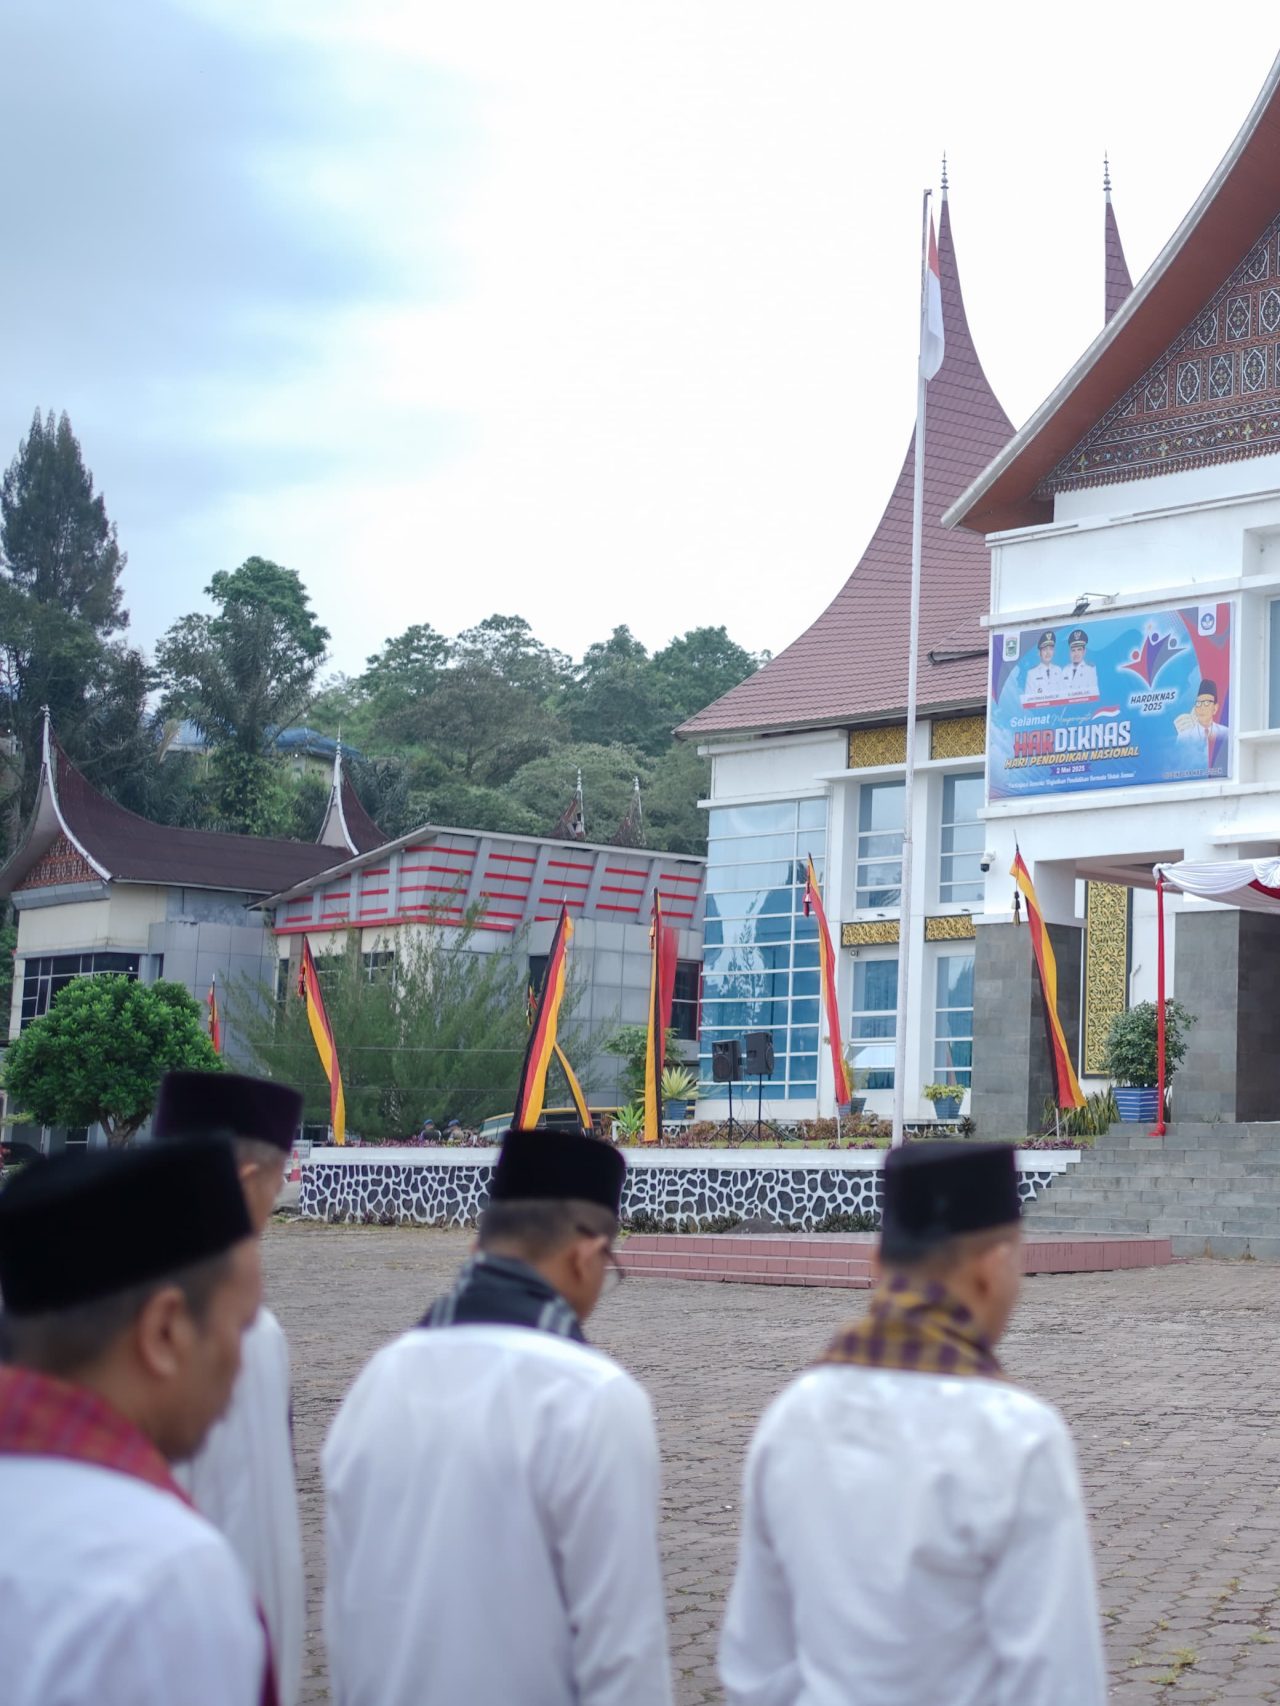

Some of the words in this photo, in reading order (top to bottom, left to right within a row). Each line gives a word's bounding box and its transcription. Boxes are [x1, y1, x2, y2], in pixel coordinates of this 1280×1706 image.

[1131, 691, 1176, 704] HARDIKNAS
[1143, 701, 1163, 712] 2025
[1010, 714, 1051, 728] Selamat
[1013, 720, 1132, 758] HARDIKNAS
[1004, 756, 1029, 769] HARI
[1030, 751, 1089, 766] PENDIDIKAN
[1090, 746, 1140, 760] NASIONAL
[1071, 765, 1086, 773] 2025
